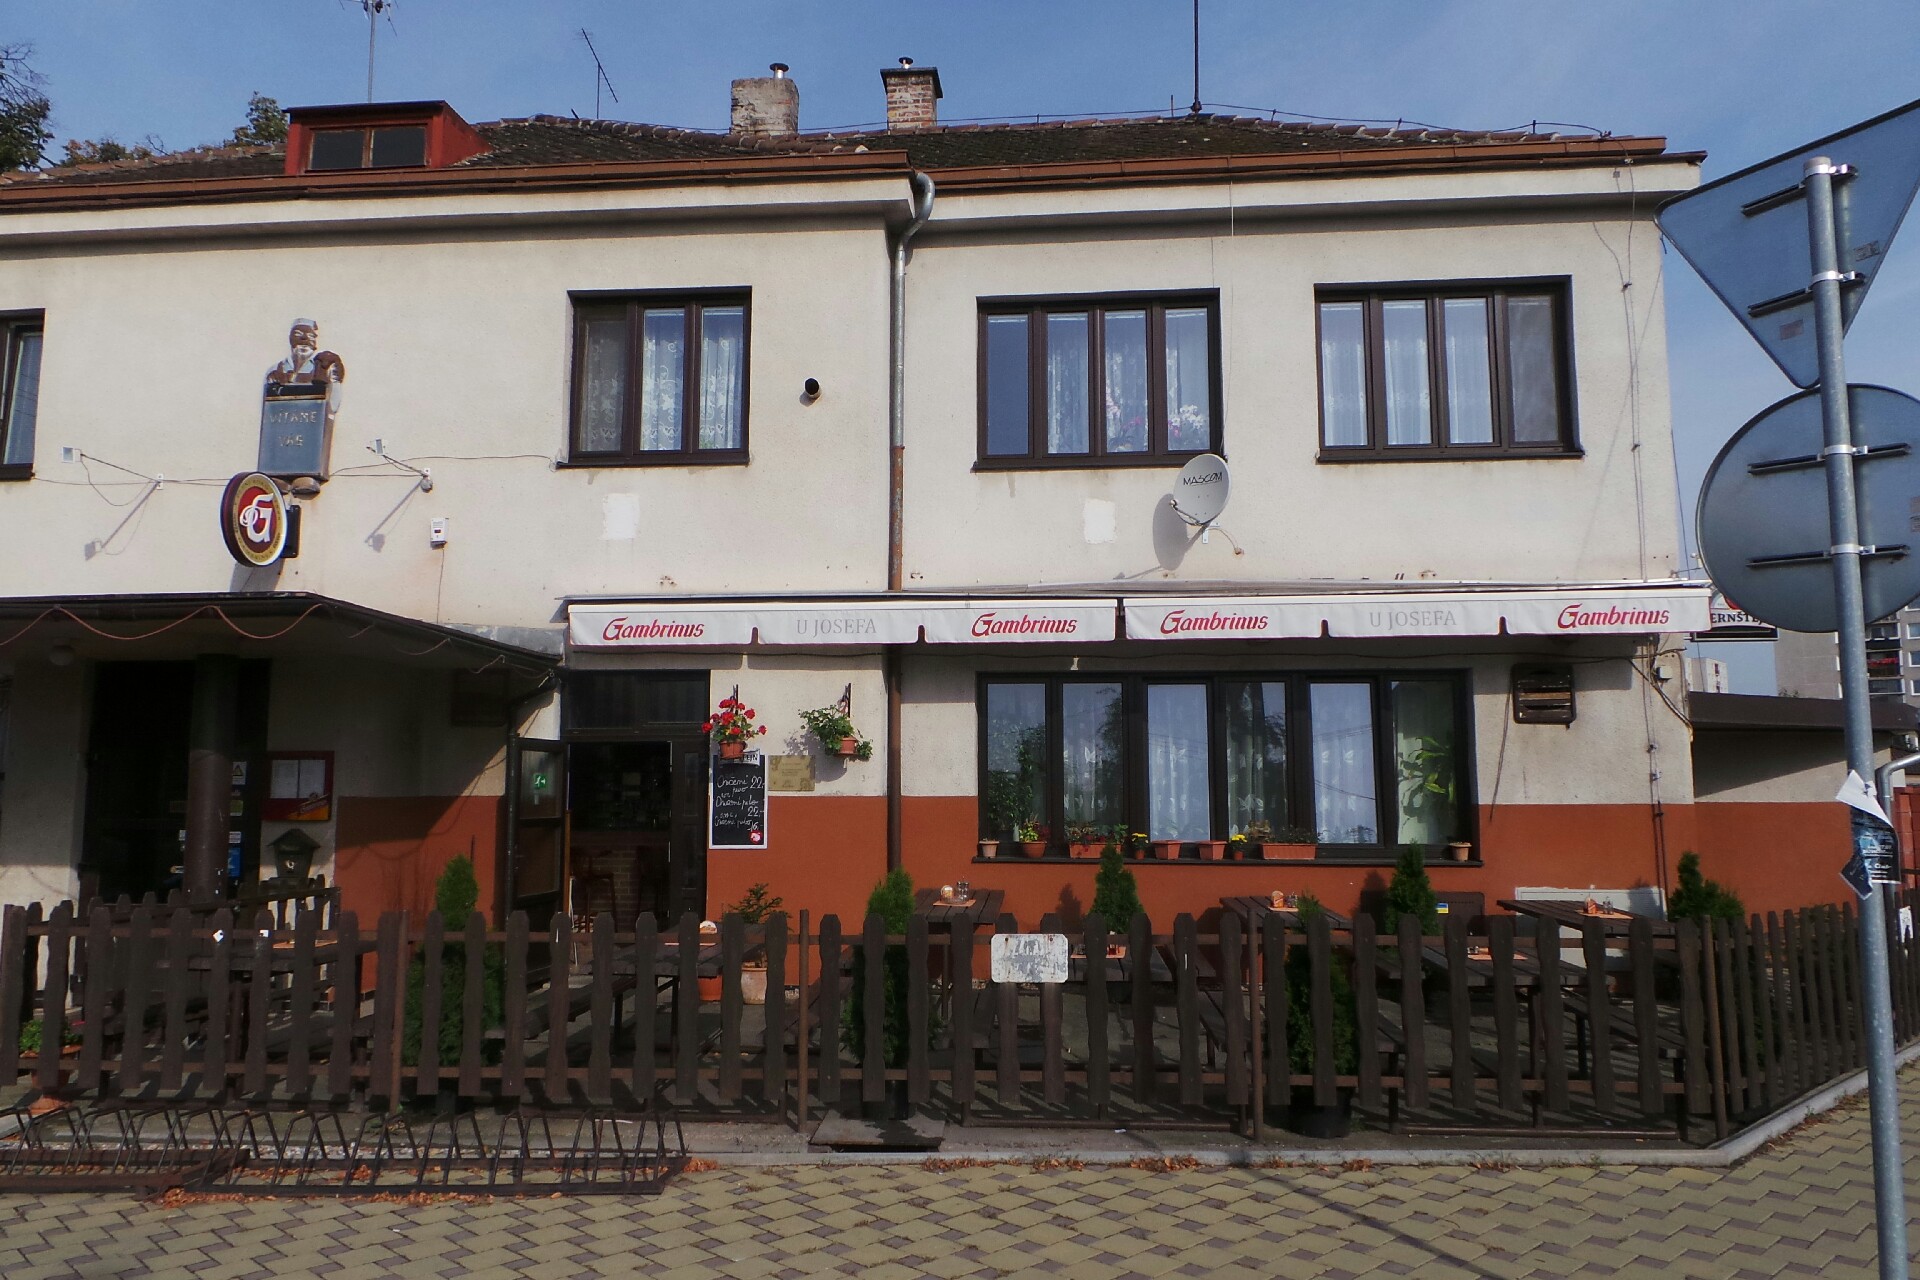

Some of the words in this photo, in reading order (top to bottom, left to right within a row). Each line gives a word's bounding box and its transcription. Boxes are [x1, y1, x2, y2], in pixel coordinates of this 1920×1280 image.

[1183, 472, 1222, 485] MASCOM
[602, 616, 705, 641] Gambrinus
[796, 619, 809, 635] U
[813, 618, 877, 638] JOSEFA
[971, 612, 1078, 638] Gambrinus
[1160, 609, 1269, 635] Gambrinus
[1369, 611, 1382, 628] U
[1385, 610, 1458, 631] JOSEFA
[1557, 604, 1670, 629] Gambrinus
